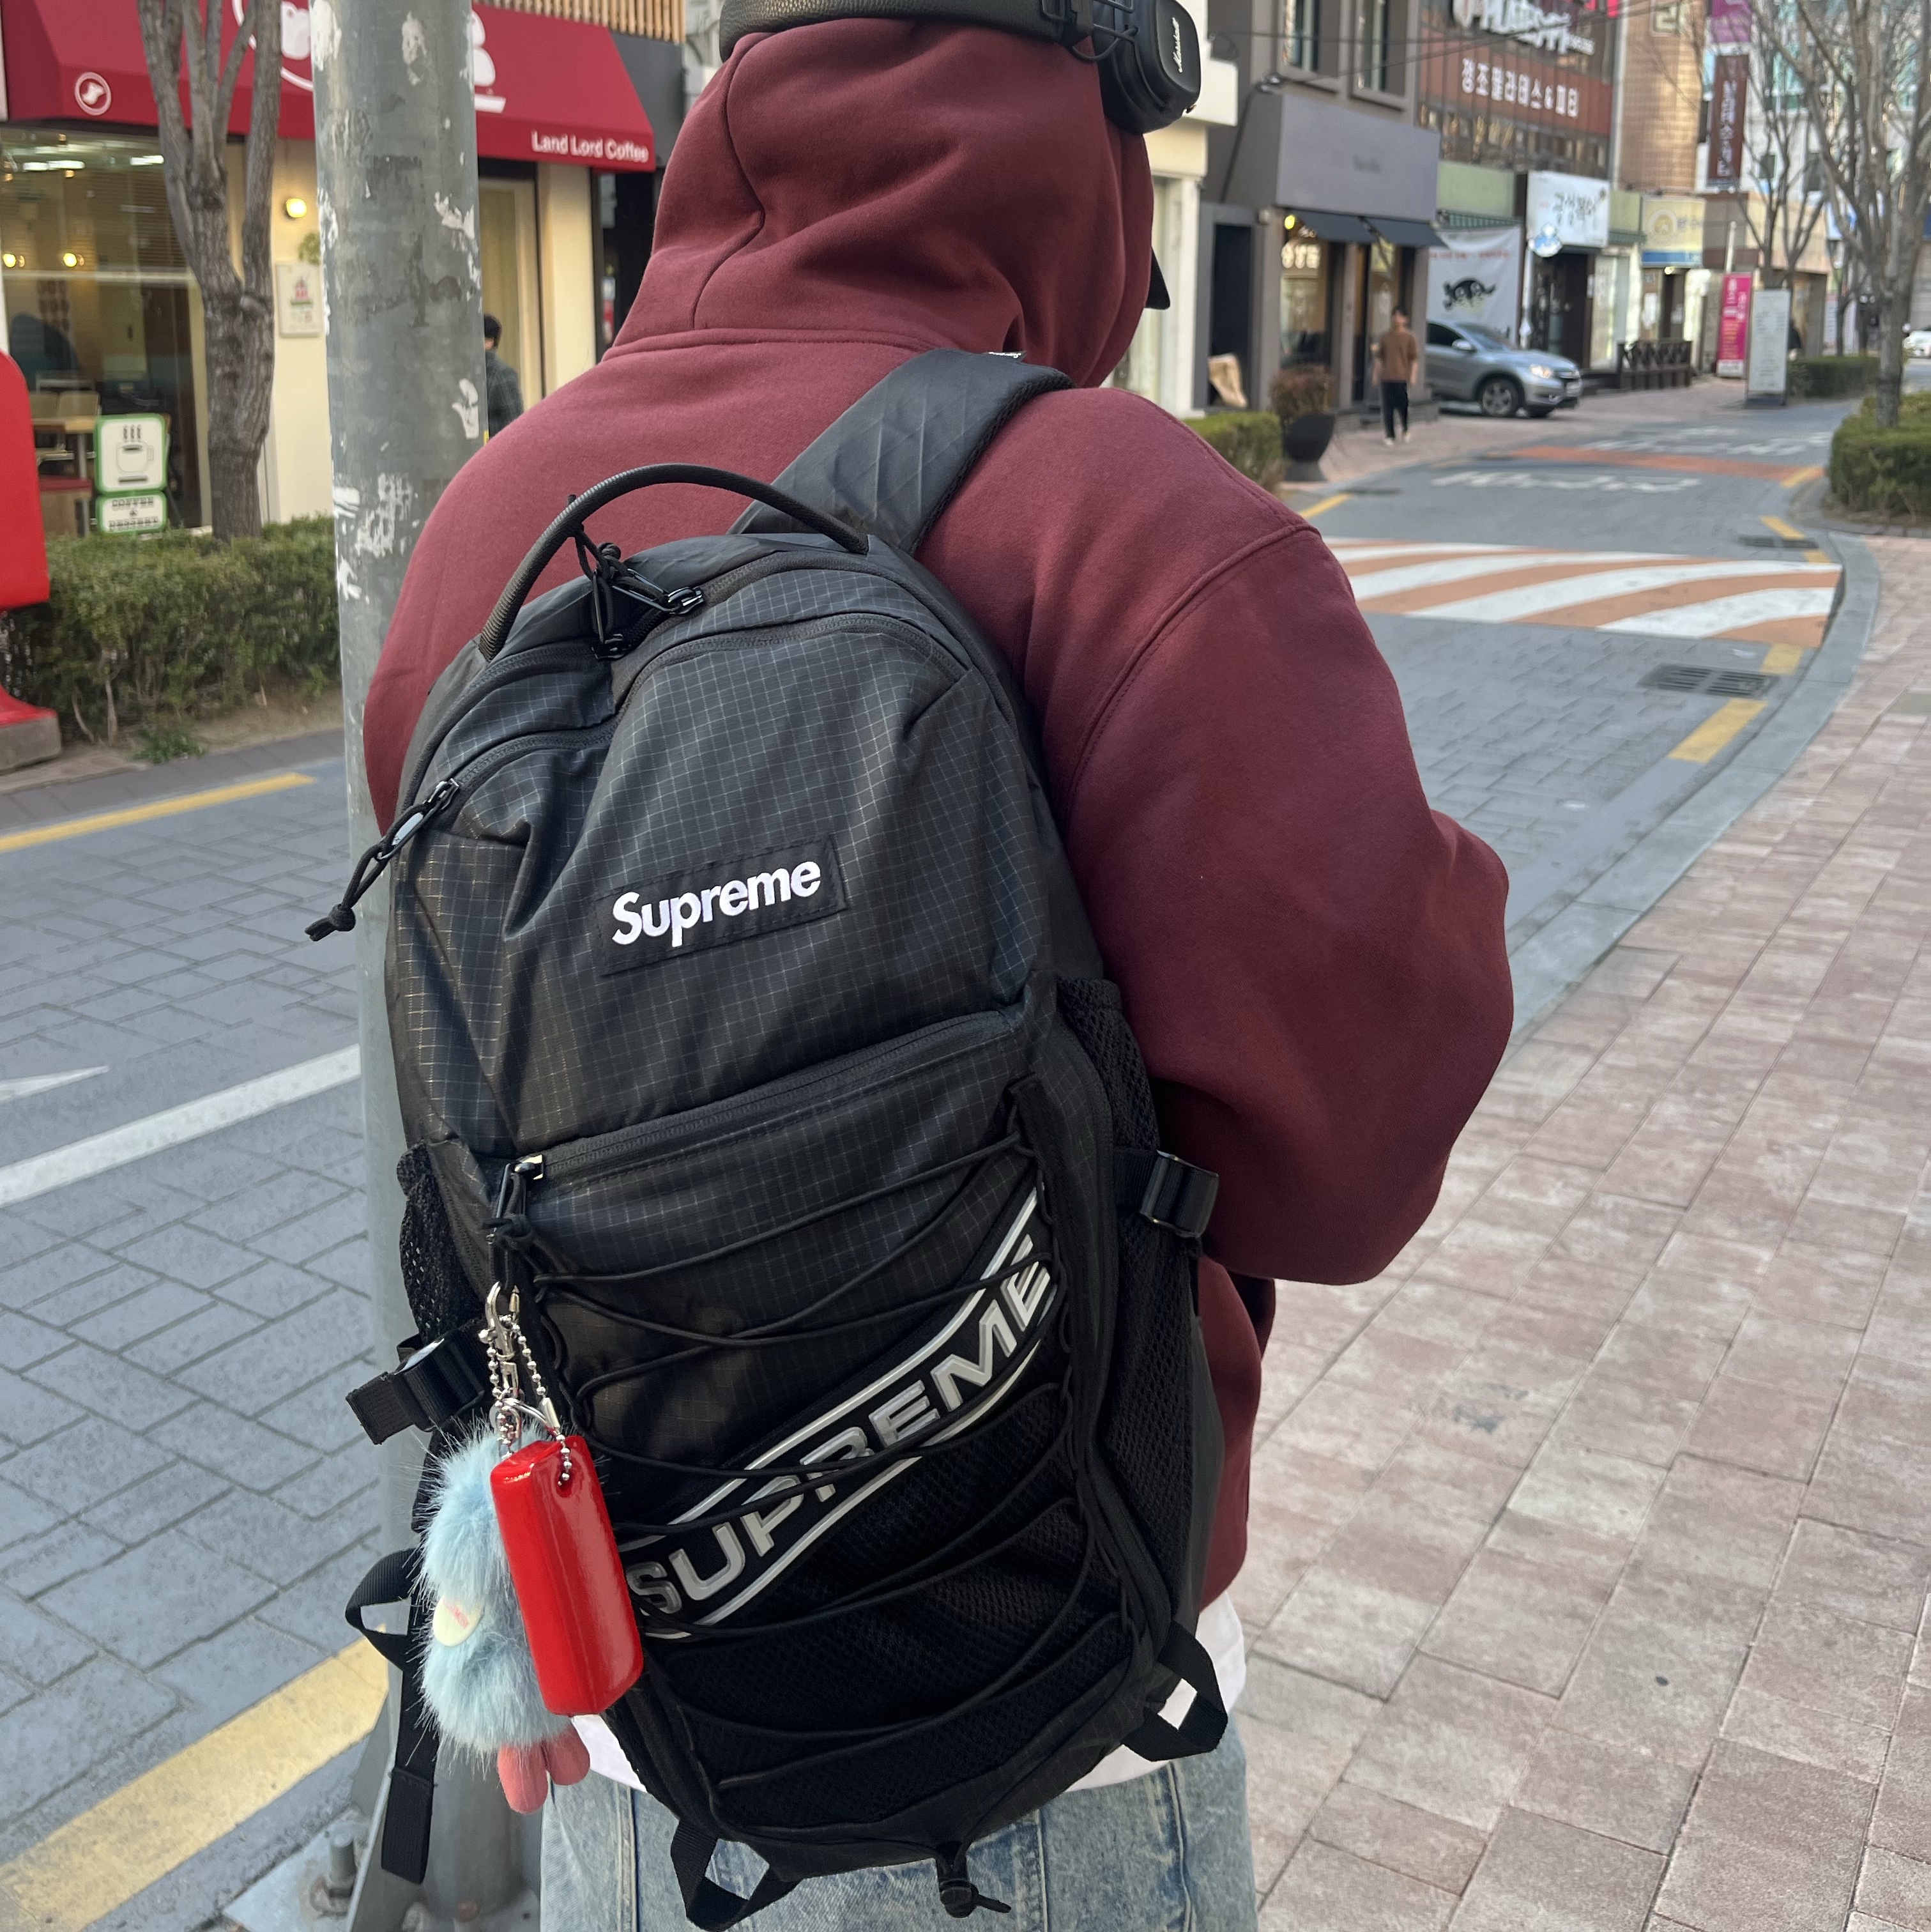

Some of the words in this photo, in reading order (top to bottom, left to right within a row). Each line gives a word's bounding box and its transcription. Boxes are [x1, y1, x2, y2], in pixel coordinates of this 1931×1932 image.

[531, 129, 569, 155] Land
[570, 134, 604, 159] Lord
[605, 137, 649, 164] Coffee
[112, 496, 155, 509] COFFEE
[611, 861, 821, 947] Supreme
[625, 1233, 1051, 1617] SUPREME
